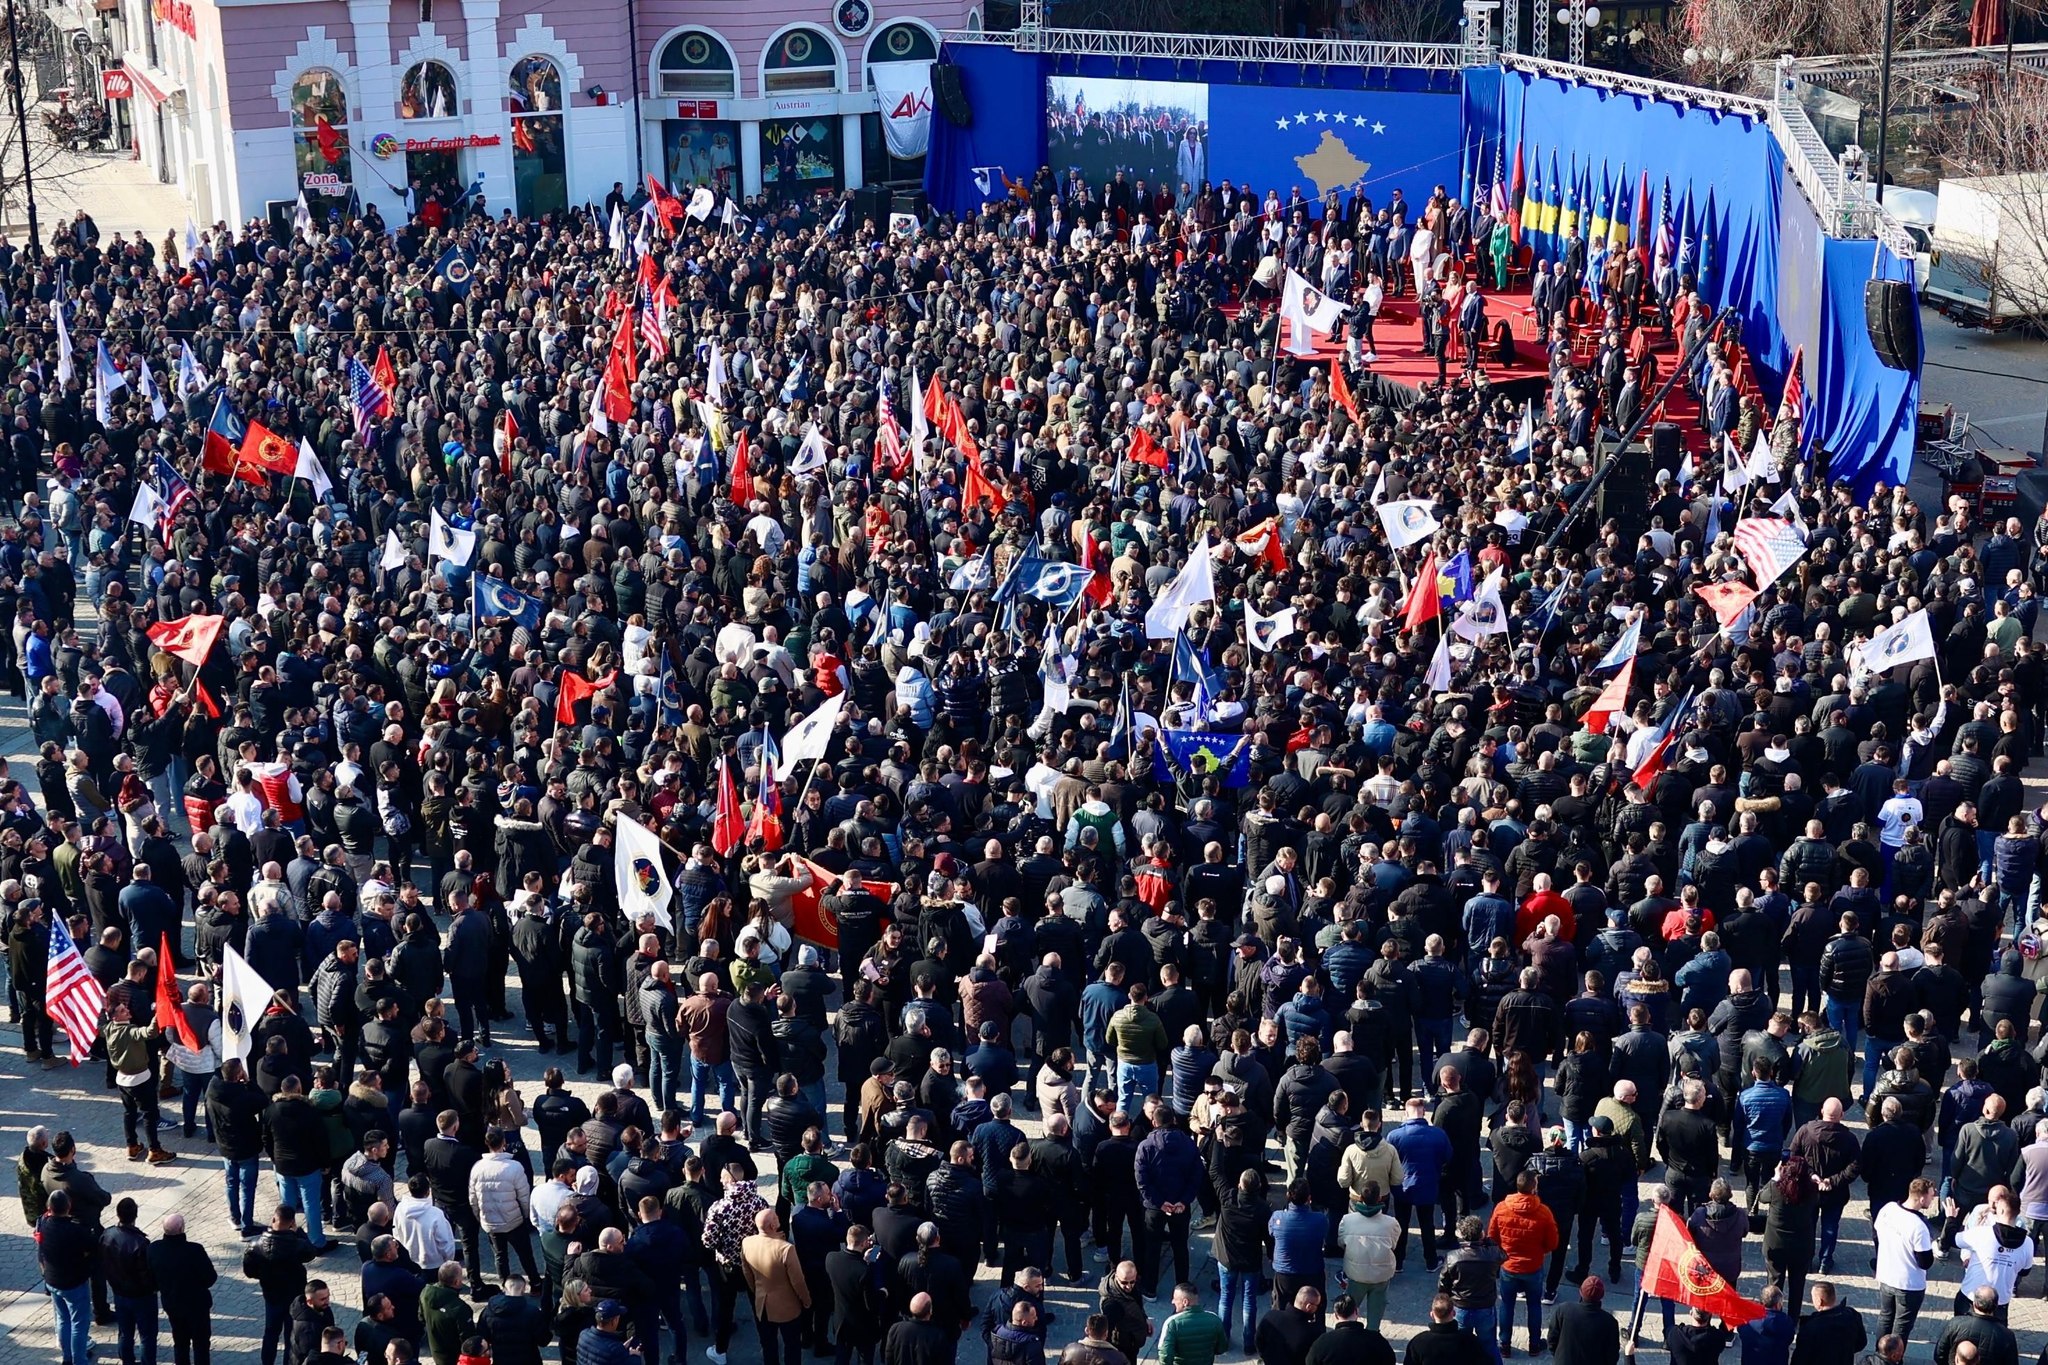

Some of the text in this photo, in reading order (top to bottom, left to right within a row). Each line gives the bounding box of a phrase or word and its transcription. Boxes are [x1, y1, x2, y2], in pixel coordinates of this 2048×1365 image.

[106, 75, 130, 95] illy
[773, 101, 811, 110] Austrian
[304, 173, 338, 185] Zona
[322, 185, 347, 196] 24/7
[1652, 580, 1664, 595] 7
